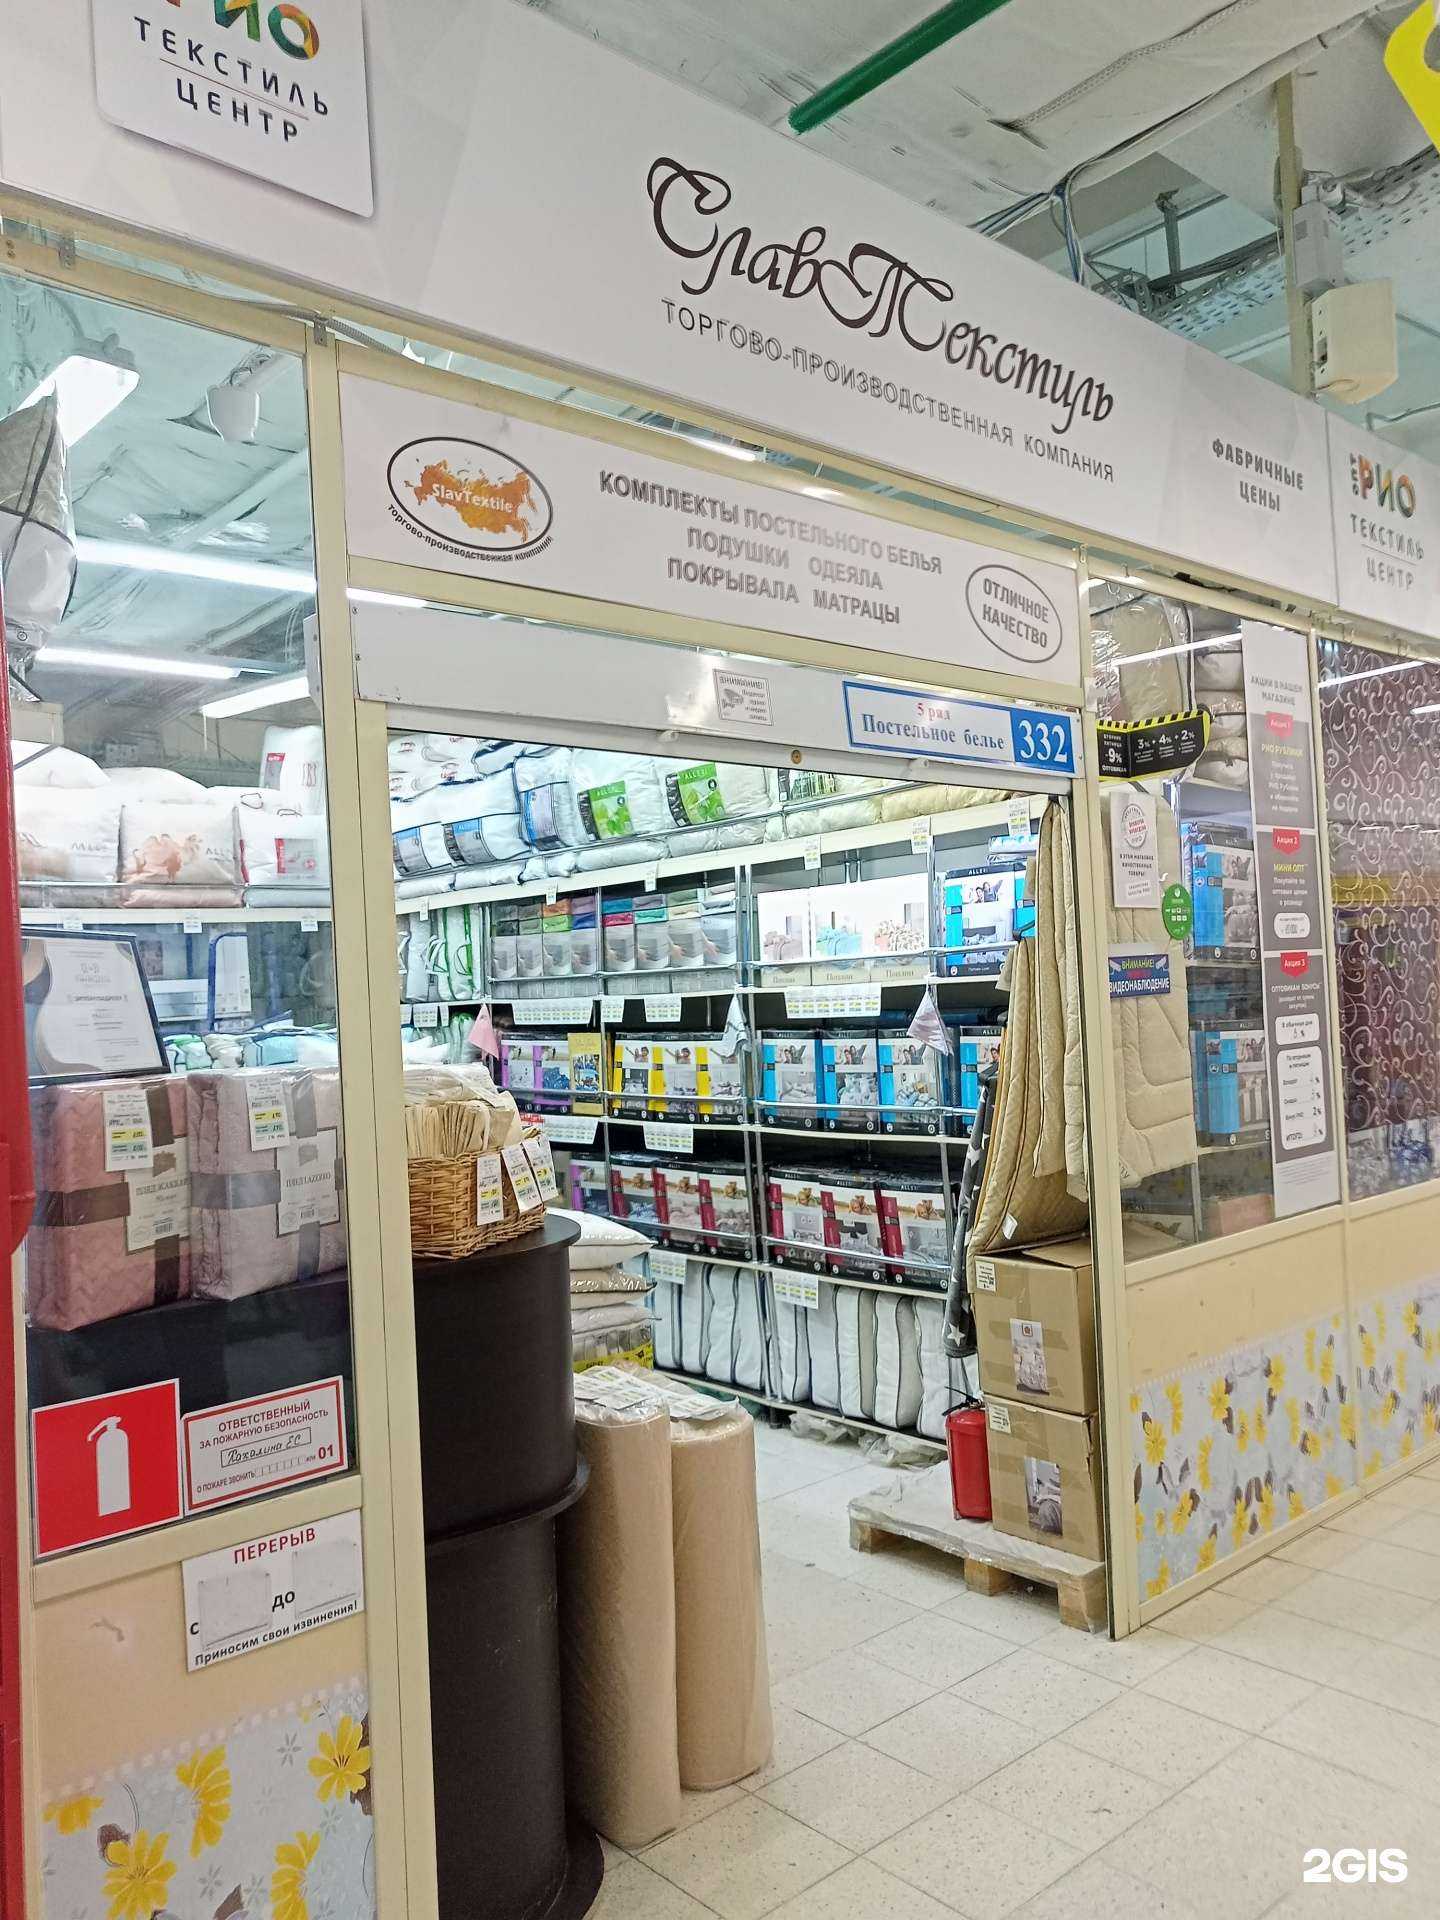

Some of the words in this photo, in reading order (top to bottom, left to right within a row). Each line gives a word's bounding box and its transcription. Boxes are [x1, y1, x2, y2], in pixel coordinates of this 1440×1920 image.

[167, 0, 320, 61] ИО
[133, 16, 328, 116] ТЕКСТИЛЬ
[176, 78, 298, 142] ЦЕНТР
[646, 156, 1115, 435] СлавТекстиль
[661, 298, 1014, 447] ТОРГОВО-ПРОИЗВОДСТВЕННАЯ
[1024, 434, 1115, 483] КОМПАНИЯ
[1212, 438, 1304, 490] ФАБРИЧНЫЕ
[1359, 454, 1417, 518] РИО
[432, 484, 512, 514] SlavTextile
[1239, 481, 1280, 512] ЦЕНЫ
[599, 470, 740, 525] КОМПЛЕКТЫ
[744, 508, 882, 559] ПОСТЕЛЬНОГО
[887, 547, 943, 575] БЕЛЬЯ
[1350, 513, 1425, 560] ТЕКСТИЛЬ
[687, 526, 790, 569] ПОДУШКИ
[808, 556, 884, 591] ОДЕЯЛА
[1366, 556, 1415, 591] ЦЕНТР
[667, 557, 800, 603] ПОКРЫВАЛА
[813, 589, 900, 624] МАТРАЦЫ
[983, 578, 1049, 624] ОТЛИЧНОЕ
[982, 604, 1047, 648] КАЧЕСТВО
[861, 713, 956, 743] Постельное
[964, 729, 1006, 749] белье
[917, 702, 924, 716] 5
[1018, 719, 1068, 763] 332
[1108, 977, 1170, 994] ВИДЕОНАБЛЮДЕНИЕ
[200, 1441, 212, 1450] ЗА
[213, 1426, 263, 1446] ПОЖАРНУЮ
[265, 1409, 329, 1431] БЕЗОПАСНОСТЬ
[219, 1399, 311, 1432] ОТВЕТСТВЕННЫЙ
[196, 1485, 202, 1493] О
[202, 1478, 228, 1491] ПОЖАРЕ
[228, 1471, 256, 1485] ЗВОНИТЬ
[318, 1444, 333, 1460] 01
[234, 1528, 316, 1564] ПЕРЕРЫВ
[195, 1637, 259, 1666] Приносим
[262, 1627, 290, 1642] свои
[293, 1600, 358, 1632] извинения!
